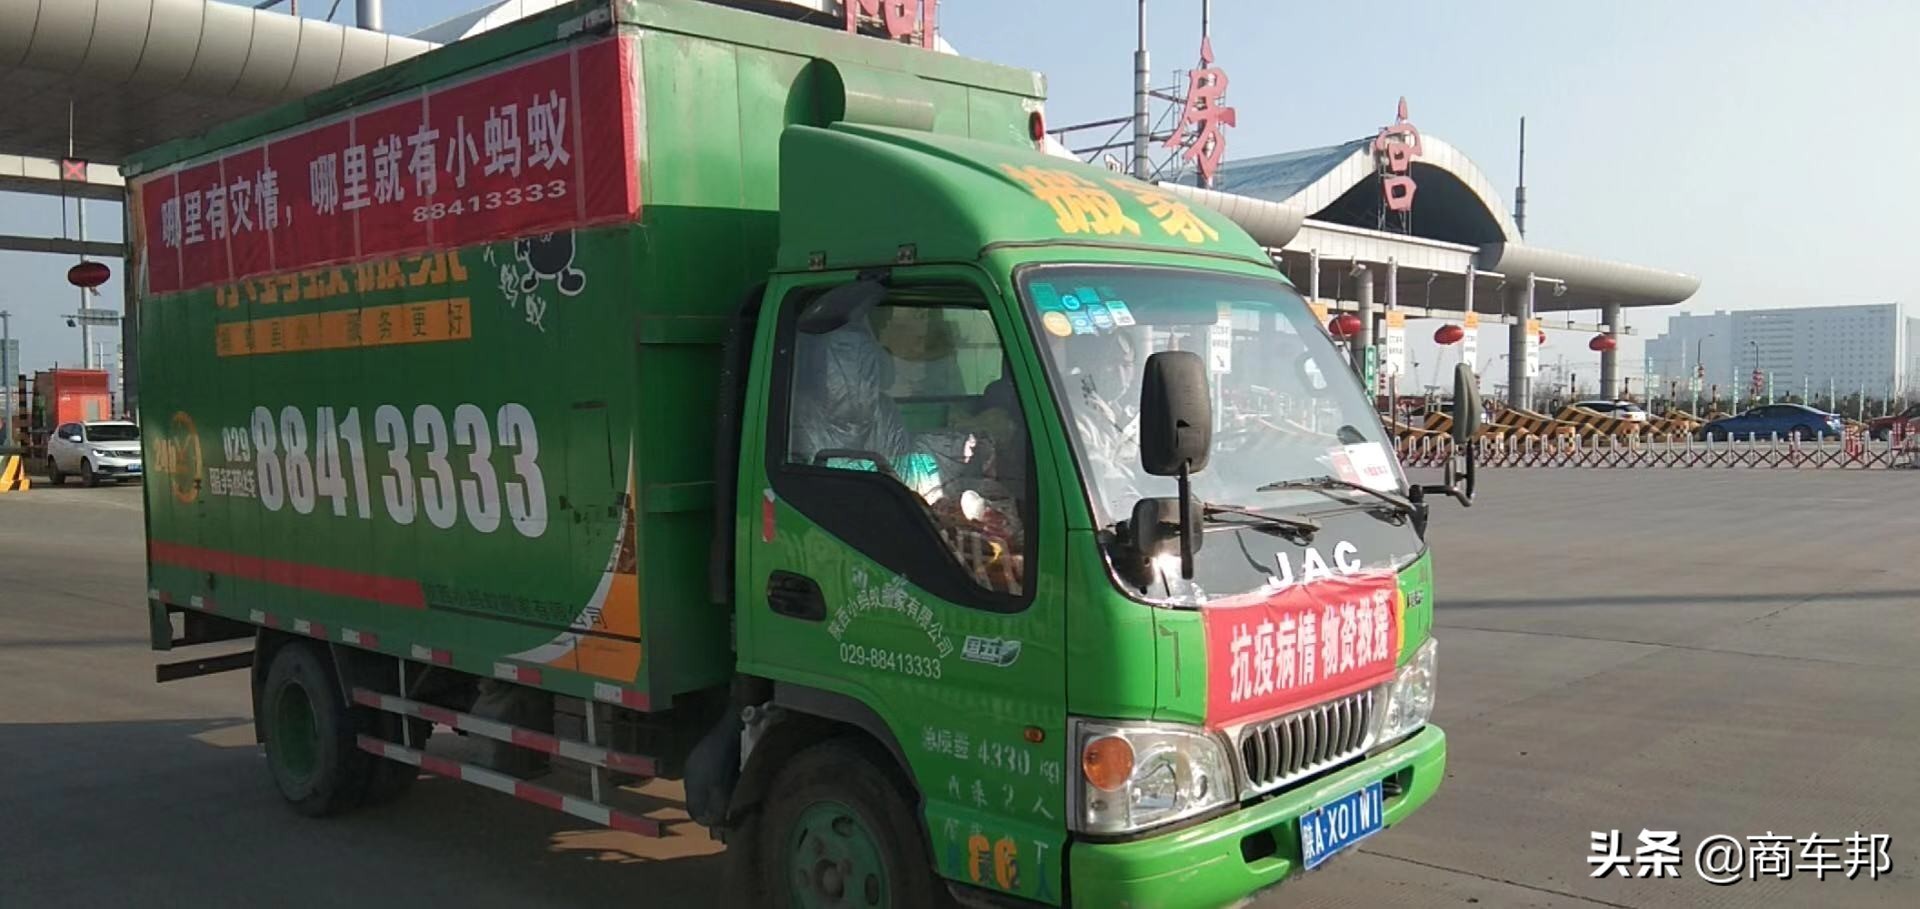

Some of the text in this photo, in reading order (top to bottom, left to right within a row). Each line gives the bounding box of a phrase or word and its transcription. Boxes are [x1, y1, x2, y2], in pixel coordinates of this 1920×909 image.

[1375, 96, 1422, 212] 宫
[412, 179, 567, 223] 88413333
[1002, 164, 1220, 243] 搬家
[222, 402, 548, 538] 029 88413333
[1267, 540, 1360, 589] JAC
[839, 642, 942, 680] 029-88413333
[1230, 589, 1392, 703] 抗疫病情 物资救援
